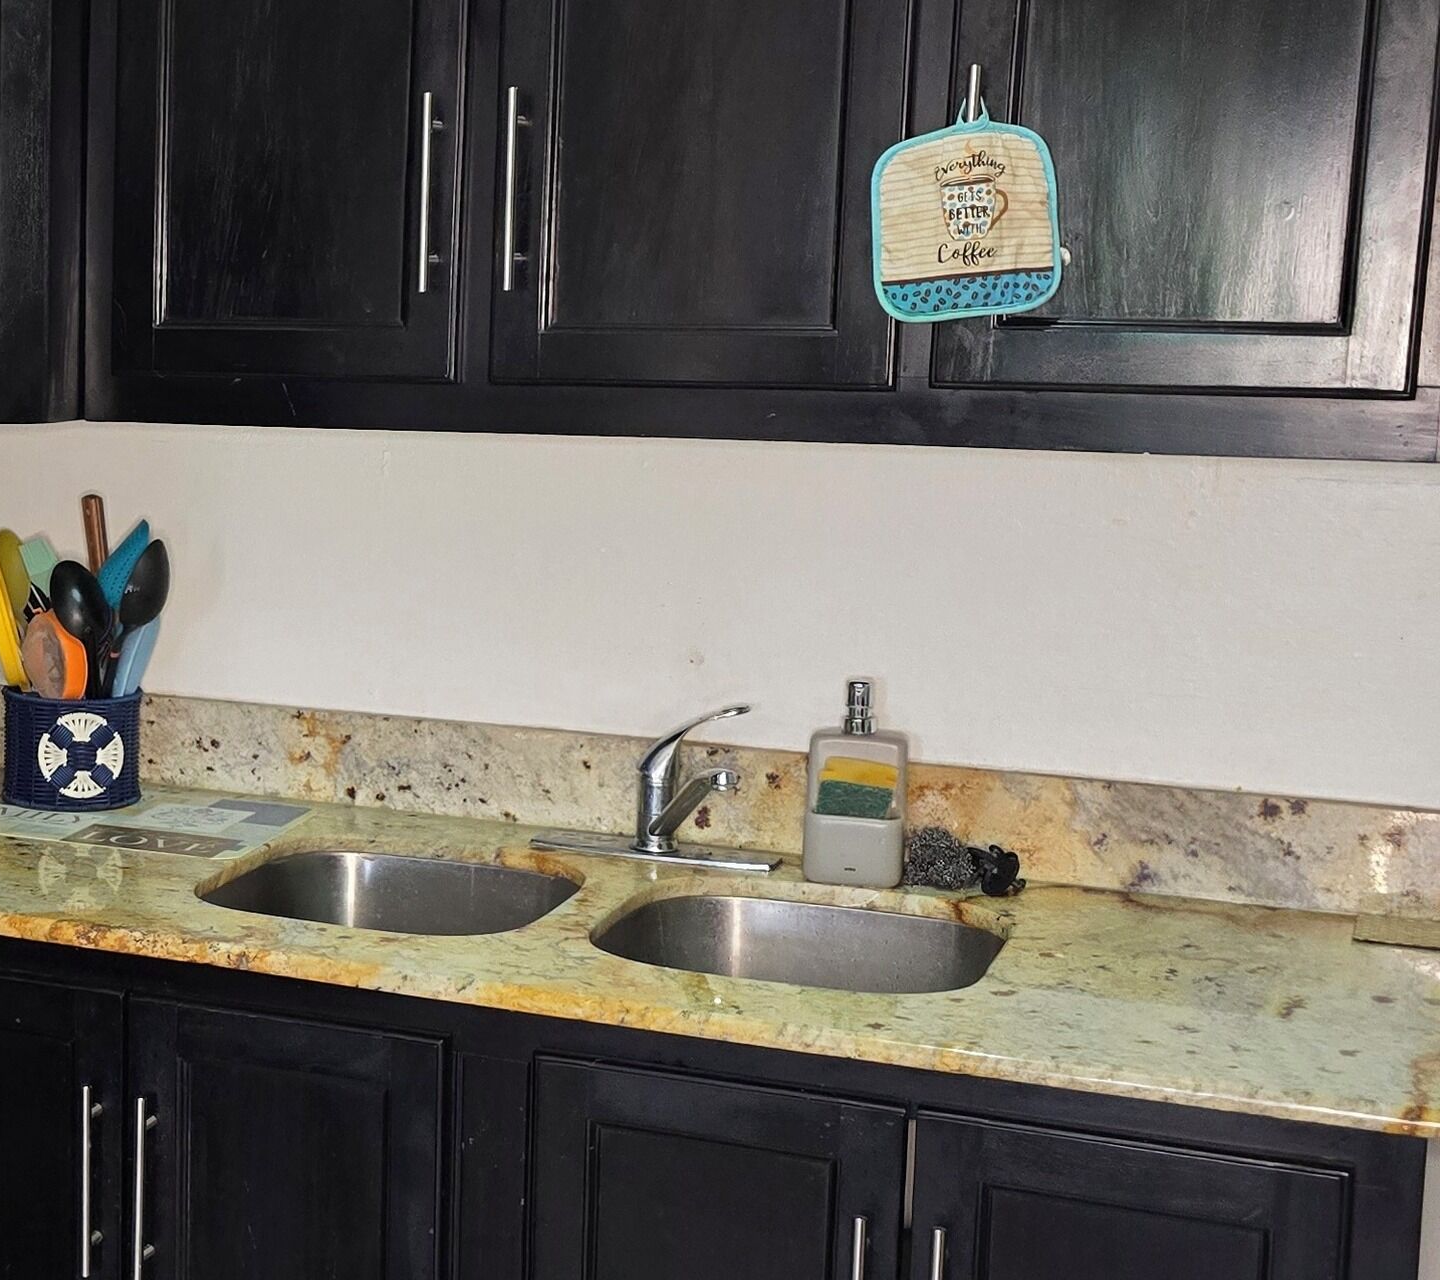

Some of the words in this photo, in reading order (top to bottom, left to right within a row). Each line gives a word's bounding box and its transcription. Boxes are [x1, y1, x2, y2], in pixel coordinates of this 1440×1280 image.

[935, 150, 1006, 181] Everything
[957, 190, 982, 203] GETS
[948, 205, 991, 221] BETTER
[956, 223, 983, 235] WITH
[937, 241, 998, 267] Coffee
[81, 830, 216, 853] LOVE
